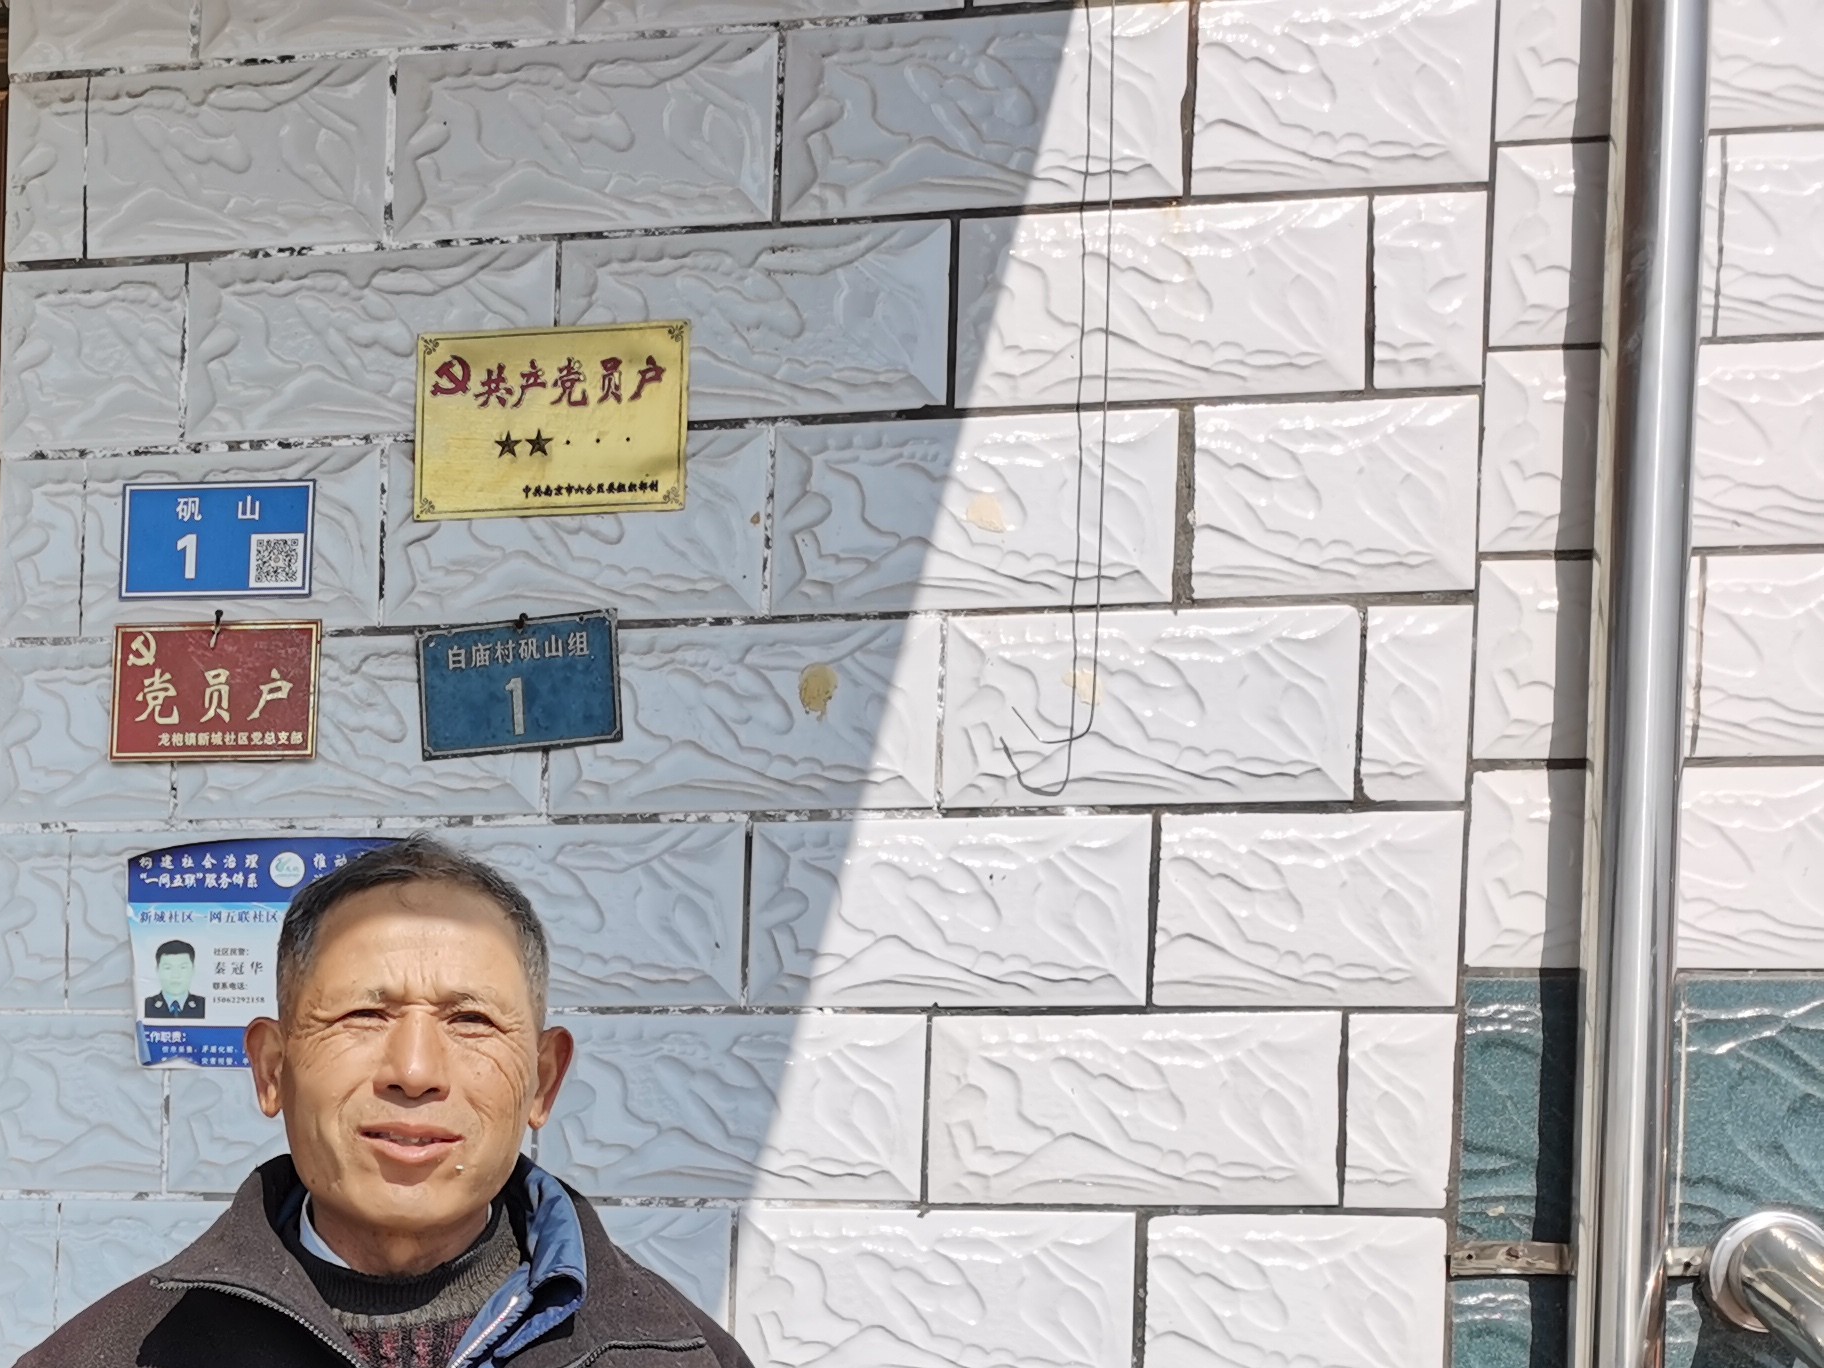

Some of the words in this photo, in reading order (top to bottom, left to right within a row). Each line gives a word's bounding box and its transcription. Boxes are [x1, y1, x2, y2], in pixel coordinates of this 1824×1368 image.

[474, 355, 666, 408] 共产党员户
[176, 494, 260, 522] 矾山
[177, 533, 197, 579] 1
[447, 631, 590, 670] 白庙村矾山组
[134, 667, 293, 725] 党员户
[505, 677, 525, 736] 1
[139, 852, 259, 870] 构建社会治理
